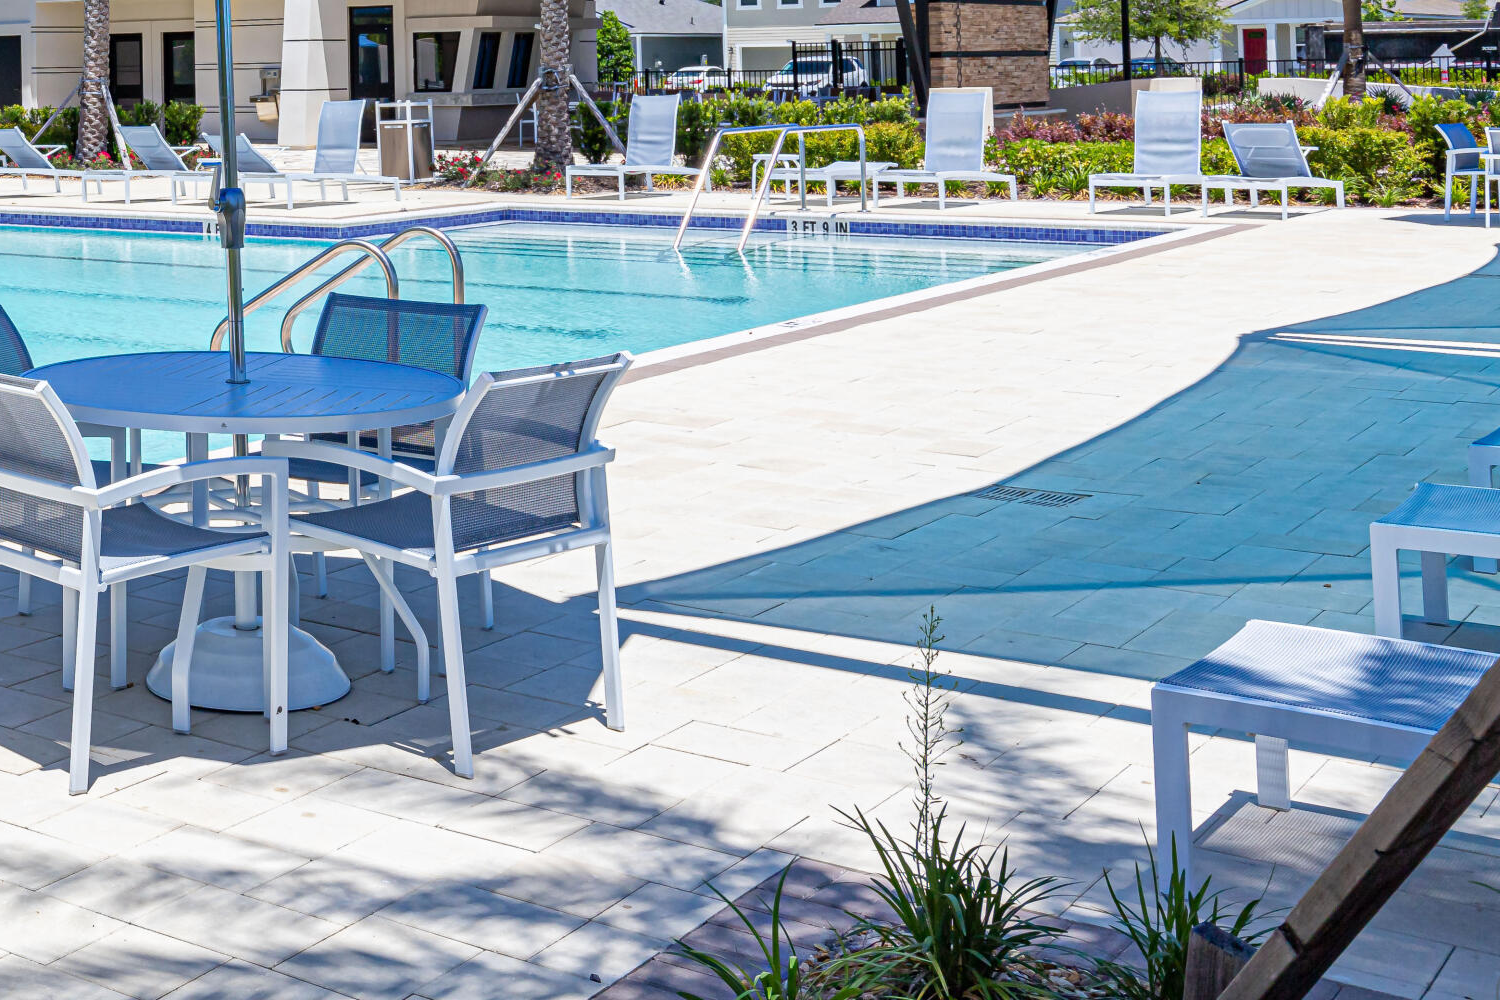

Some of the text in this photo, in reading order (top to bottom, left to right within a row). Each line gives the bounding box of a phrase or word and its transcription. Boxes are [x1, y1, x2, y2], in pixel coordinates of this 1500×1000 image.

[791, 220, 848, 233] 3 FT 9 IN
